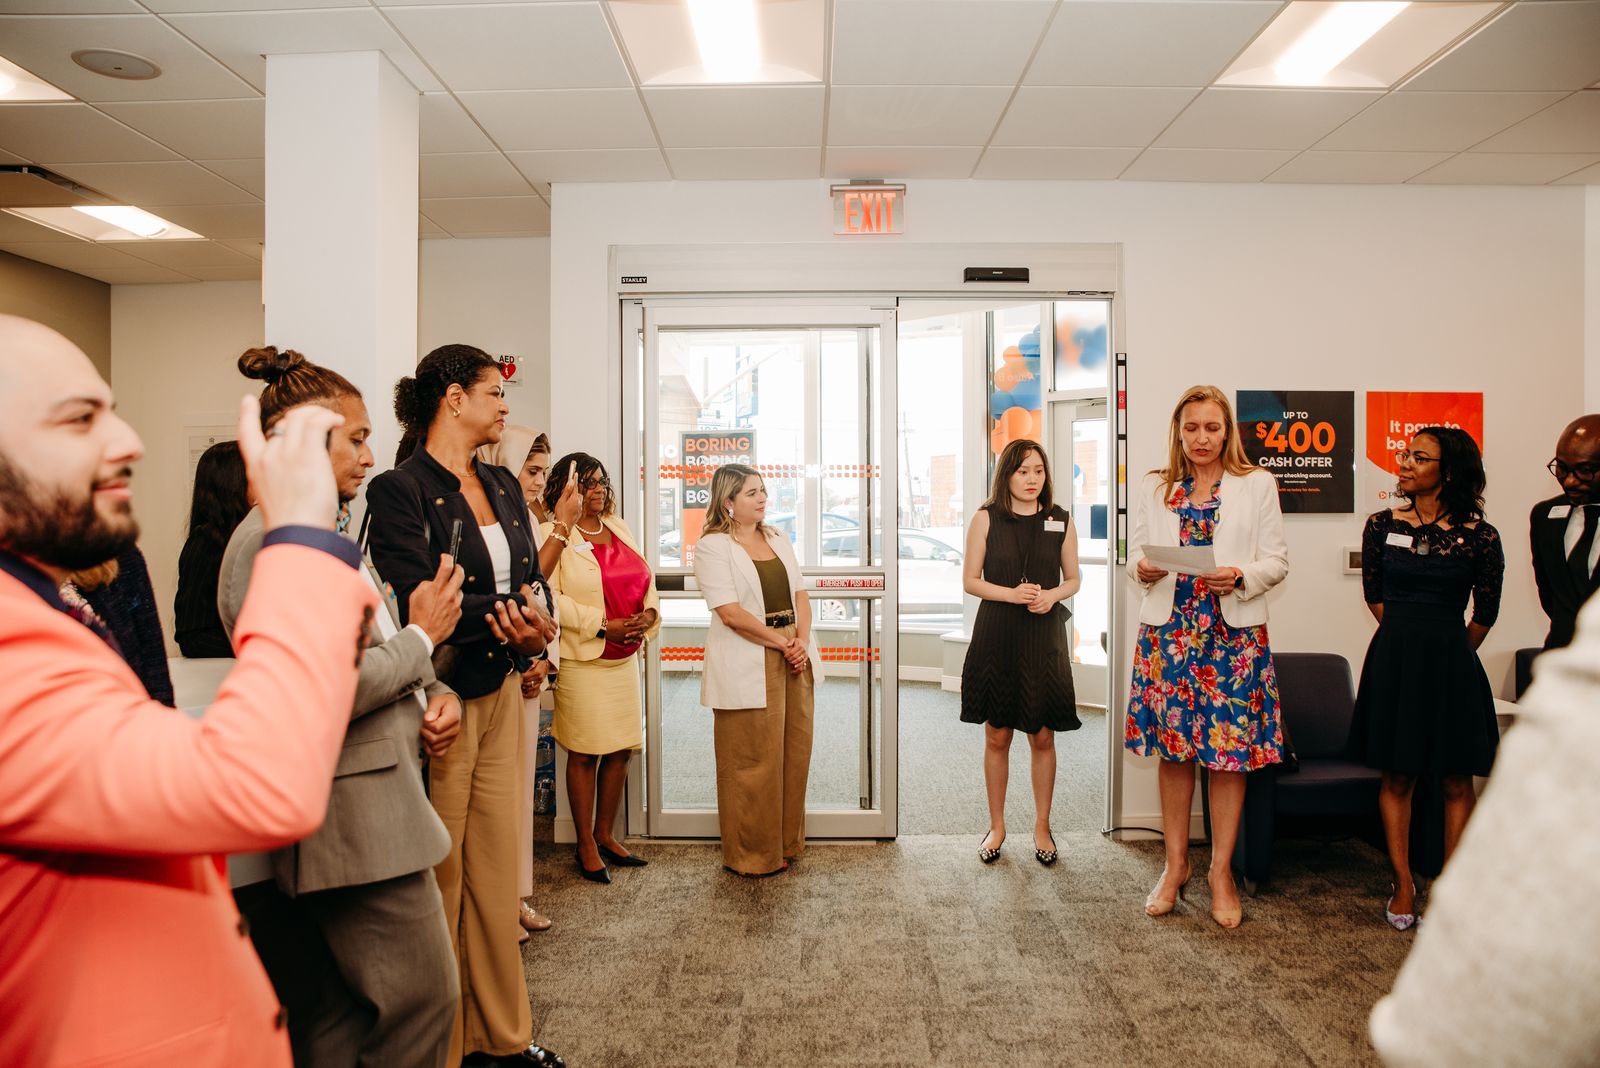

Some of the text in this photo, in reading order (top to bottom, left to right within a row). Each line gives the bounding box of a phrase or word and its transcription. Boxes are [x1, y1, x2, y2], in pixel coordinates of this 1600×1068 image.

[845, 193, 896, 232] EXIT
[499, 355, 514, 363] AED
[1283, 411, 1309, 419] UP TO
[1389, 420, 1401, 433] It
[1256, 421, 1336, 453] $400
[1386, 436, 1407, 450] be
[685, 437, 750, 452] BORING
[1259, 456, 1333, 468] CASH OFFER
